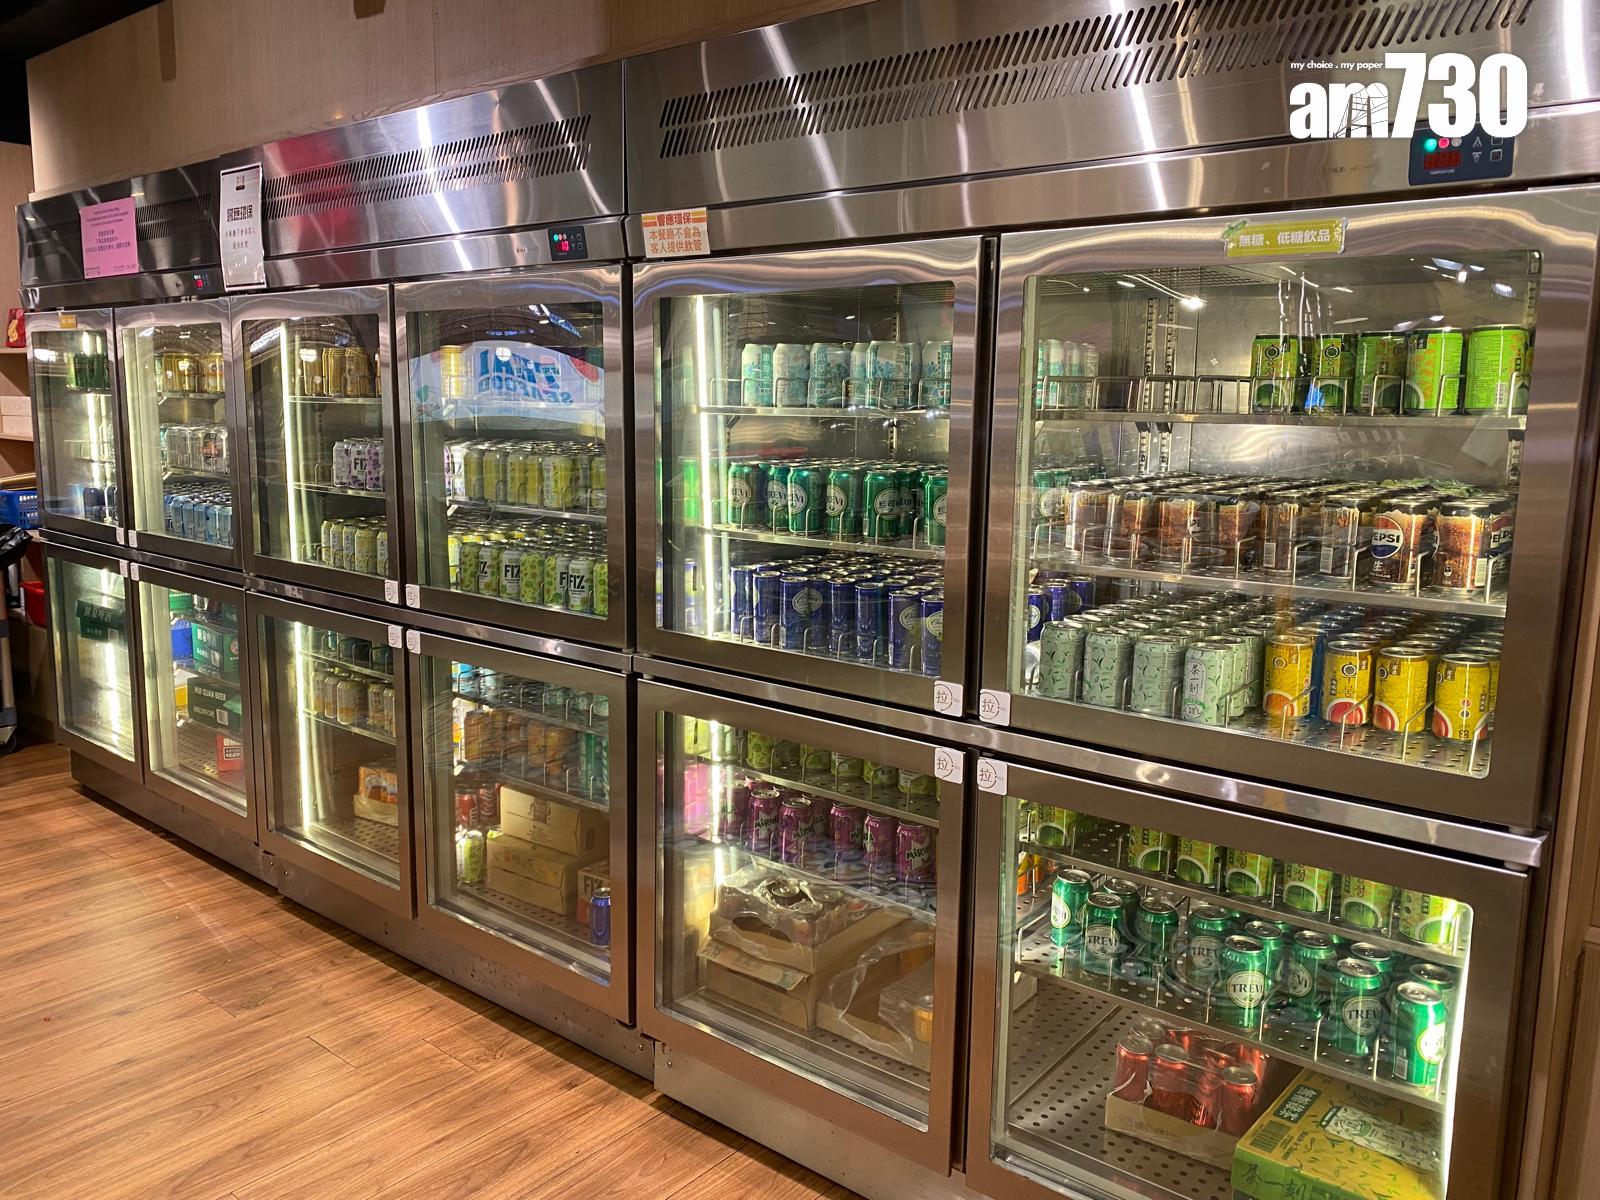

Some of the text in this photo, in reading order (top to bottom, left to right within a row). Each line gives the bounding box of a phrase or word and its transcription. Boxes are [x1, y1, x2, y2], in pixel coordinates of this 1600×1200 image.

[648, 226, 702, 241] 本餐廳不會為
[1238, 229, 1331, 248] 無糖、低糖飲品
[650, 239, 702, 255] 客人提供飲管
[1373, 531, 1401, 544] EPSI
[936, 689, 949, 705] 拉
[982, 698, 996, 714] 拉
[937, 757, 950, 772] 拉
[979, 767, 993, 783] 拉
[1231, 983, 1263, 994] TREVI
